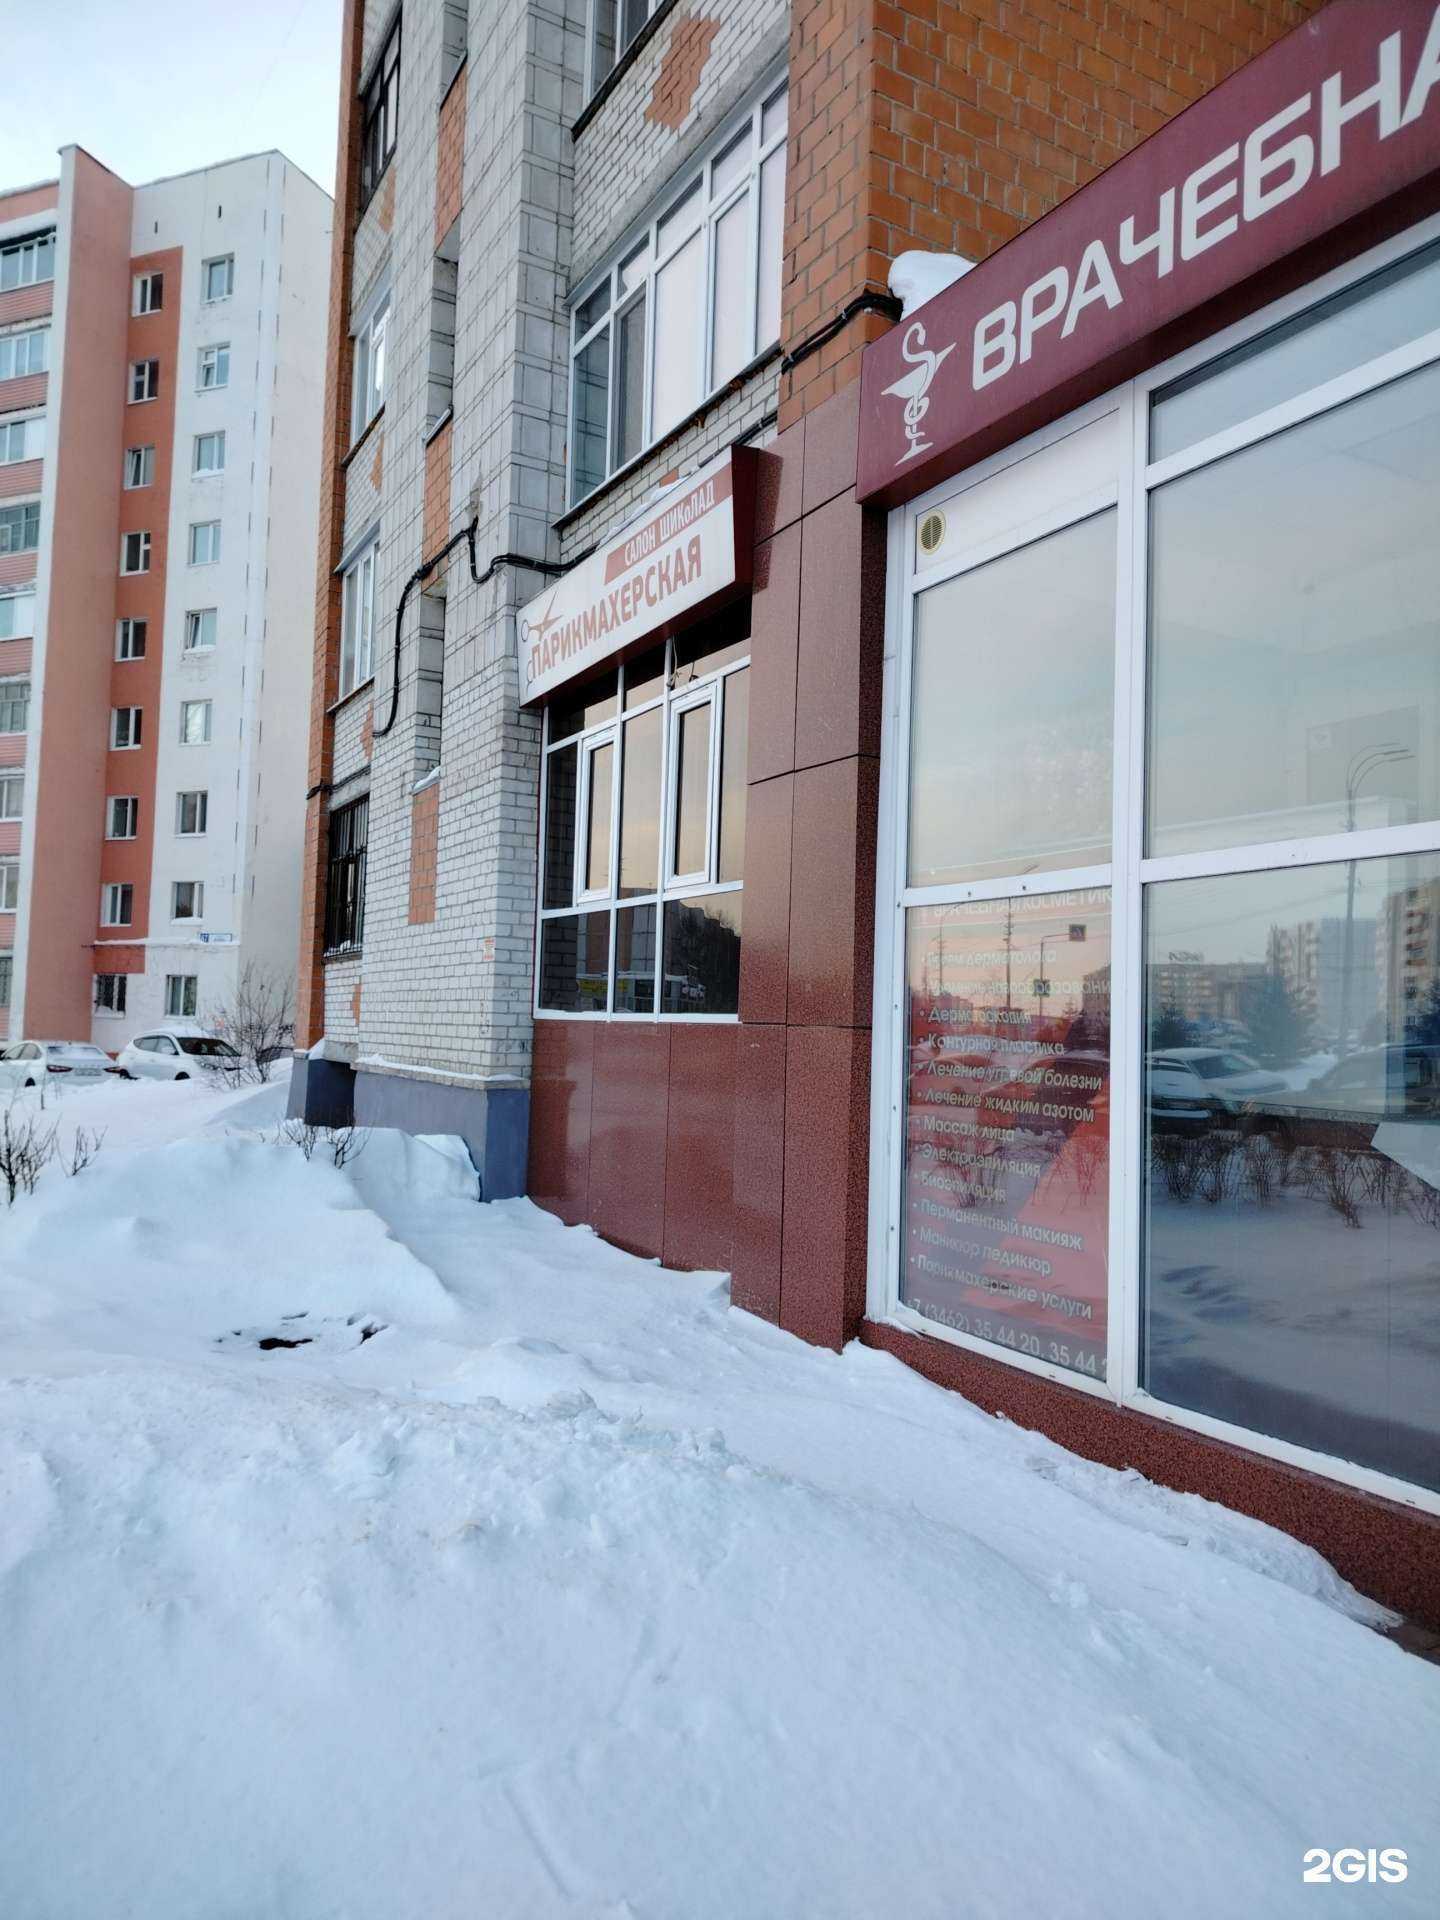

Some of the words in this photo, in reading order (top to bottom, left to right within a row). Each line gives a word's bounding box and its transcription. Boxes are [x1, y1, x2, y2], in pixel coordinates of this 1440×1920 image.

[625, 524, 656, 567] САЛОН
[531, 533, 702, 679] ПАРИКМАХЕРСКАЯ
[928, 1062, 984, 1079] Лечение
[1045, 1069, 1103, 1091] болезни
[925, 1088, 982, 1107] Лечение
[985, 1096, 1040, 1116] жидким
[1042, 1104, 1095, 1122] азотом
[923, 1115, 978, 1136] Массаж
[980, 1127, 1015, 1143] лица
[920, 1143, 1041, 1177] Электроэпиляция
[1022, 1228, 1083, 1250] макияж
[982, 1246, 1051, 1277] педикюр
[1041, 1287, 1092, 1320] услуги
[974, 1318, 993, 1340] 35
[1049, 1341, 1071, 1367] 35
[1074, 1350, 1097, 1376] 44
